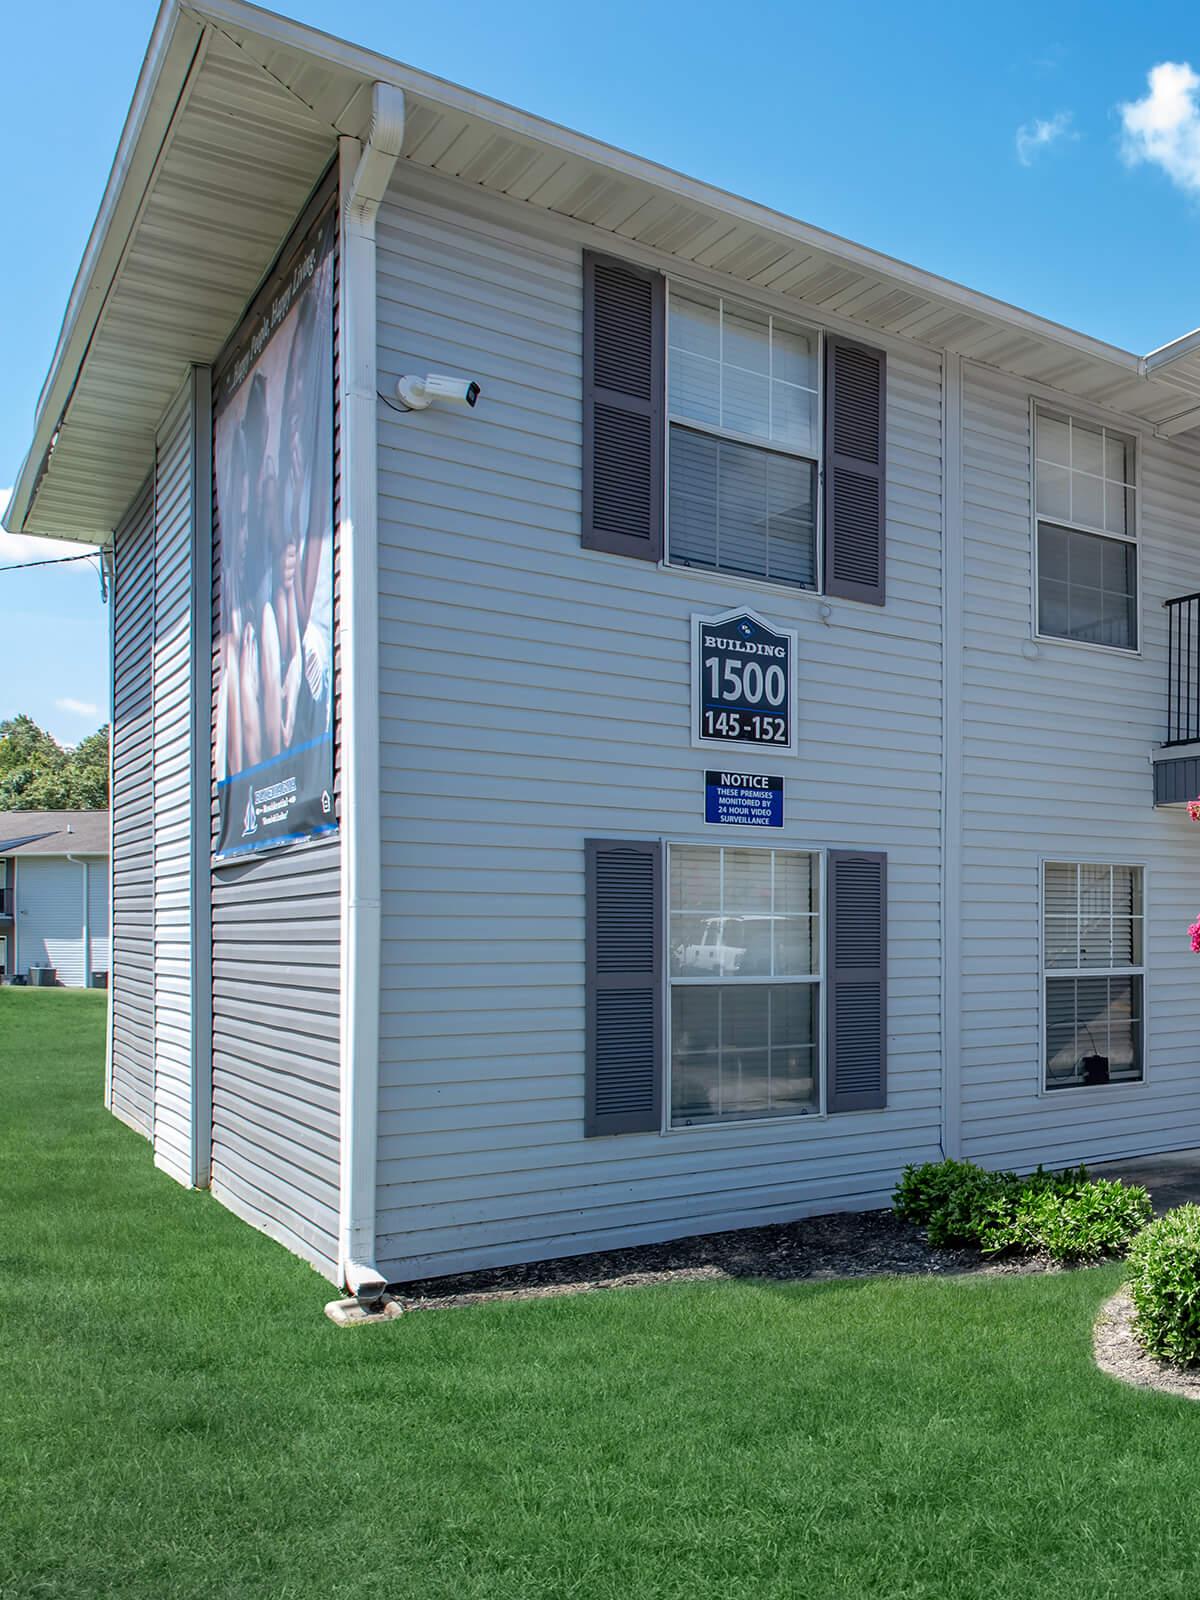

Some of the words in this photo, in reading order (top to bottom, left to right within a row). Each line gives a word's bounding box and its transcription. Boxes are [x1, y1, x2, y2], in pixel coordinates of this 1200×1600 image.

[704, 635, 786, 658] BUILDING
[705, 656, 785, 706] 1500
[721, 773, 769, 789] NOTICE
[717, 787, 739, 797] THESE
[740, 789, 773, 799] PREMISES
[719, 797, 760, 807] MONITORED
[729, 806, 749, 815] HOUR
[751, 808, 772, 816] VIDEO
[720, 815, 770, 825] SURVEILLANCE
